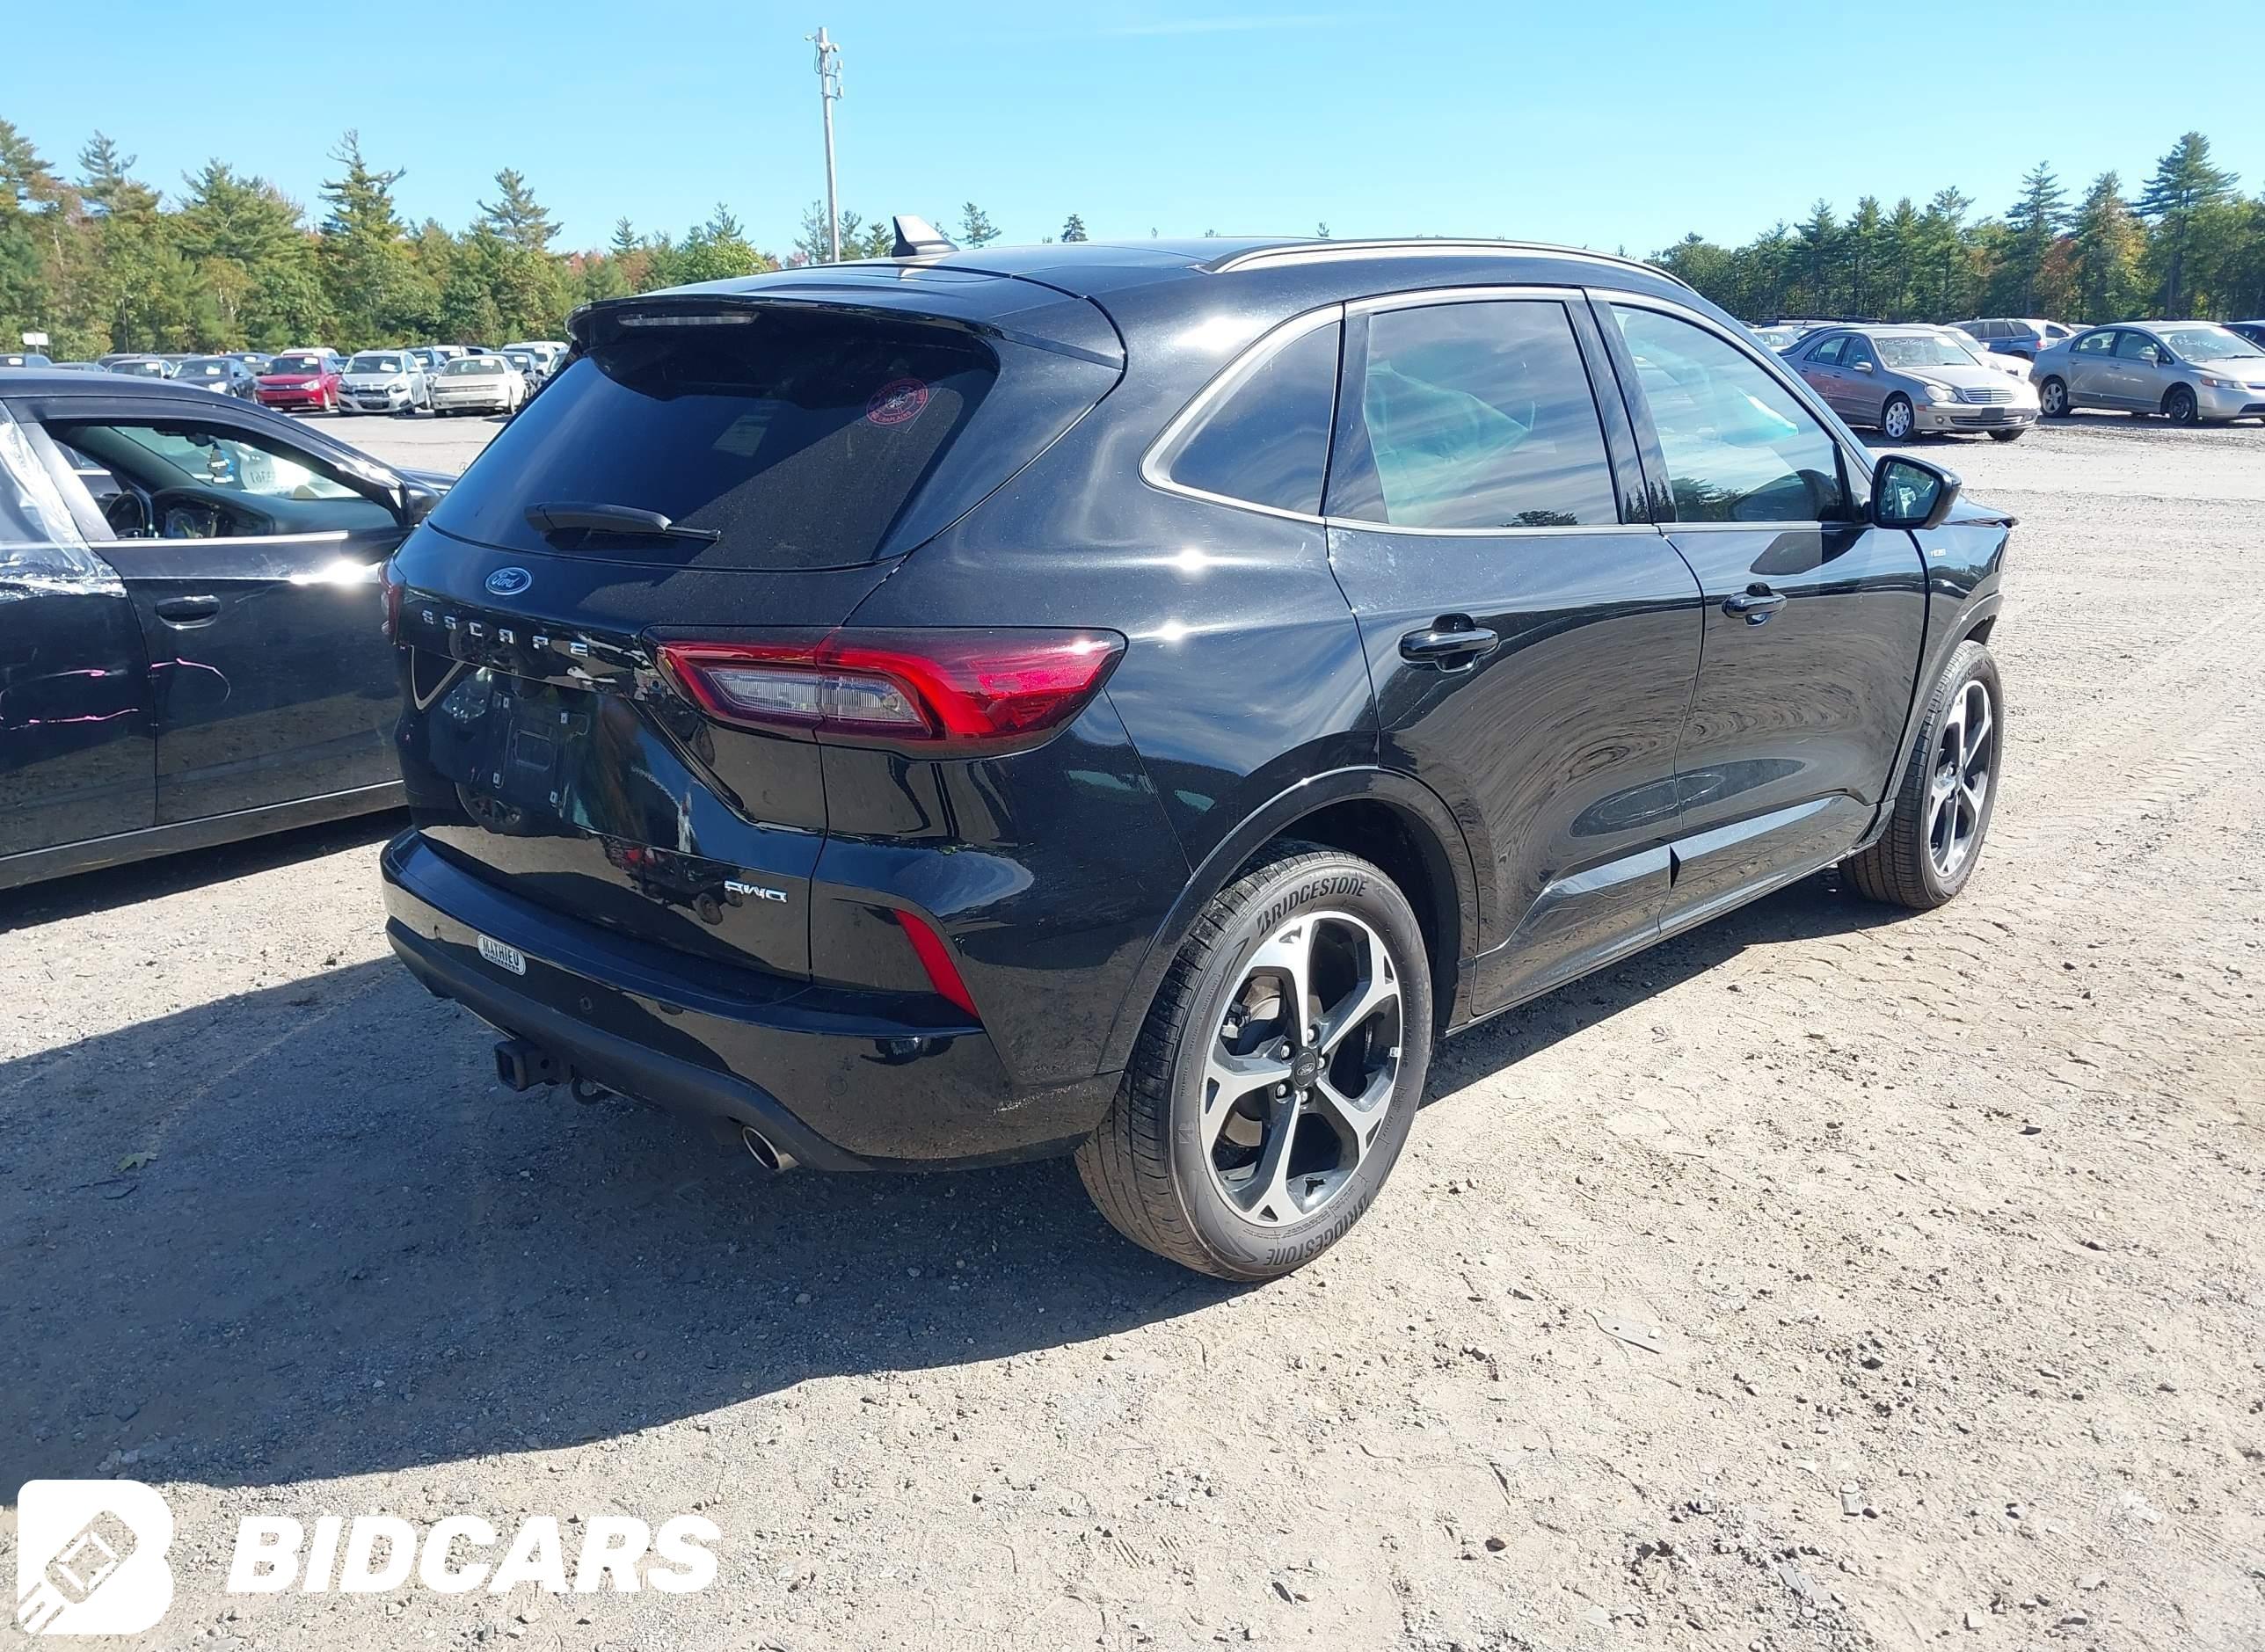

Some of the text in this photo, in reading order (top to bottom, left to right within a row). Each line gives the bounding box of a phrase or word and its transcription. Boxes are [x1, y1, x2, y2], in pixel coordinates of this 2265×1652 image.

[421, 609, 589, 658] ESCAPE
[1257, 877, 1368, 938] BRIDGESTONE
[483, 938, 520, 967] MATHIEU
